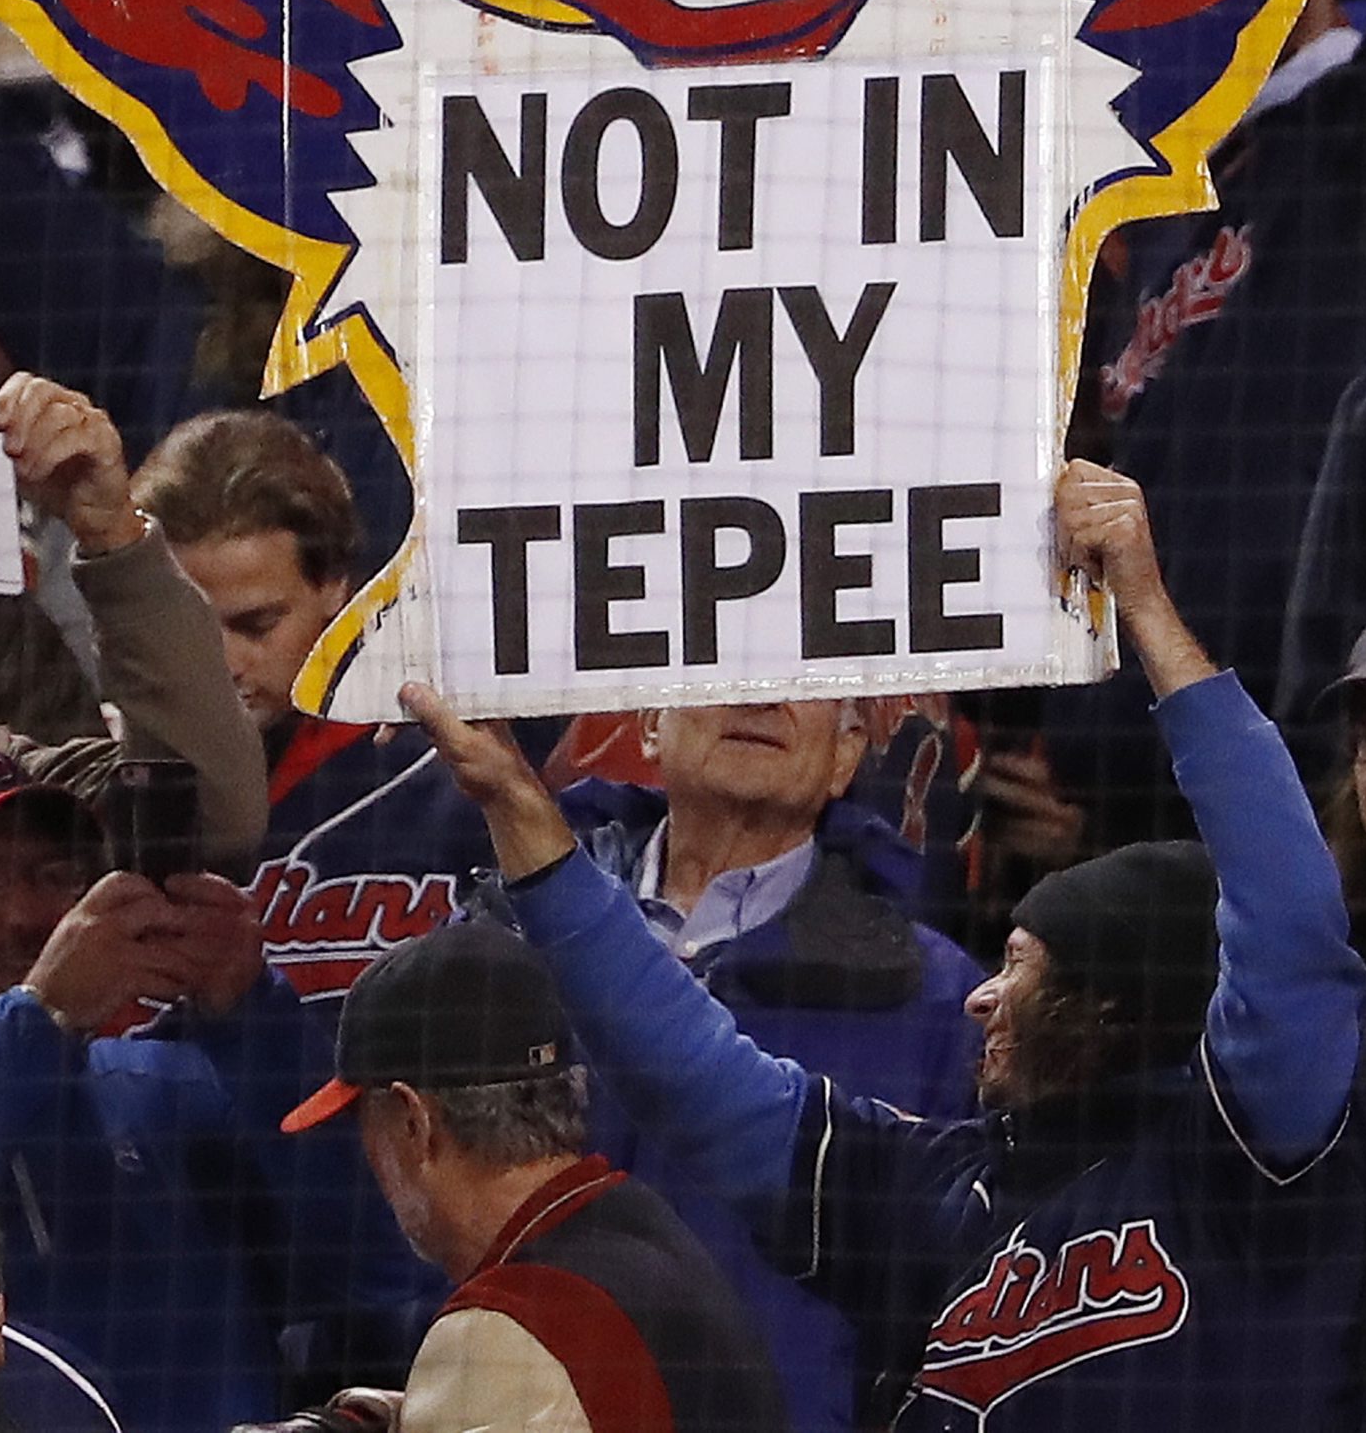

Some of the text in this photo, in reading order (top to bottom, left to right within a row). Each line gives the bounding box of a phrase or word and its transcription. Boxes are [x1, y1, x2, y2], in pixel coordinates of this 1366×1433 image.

[440, 70, 1027, 265] NOT IN
[633, 282, 899, 467] MY
[457, 483, 1005, 676] TEPEE
